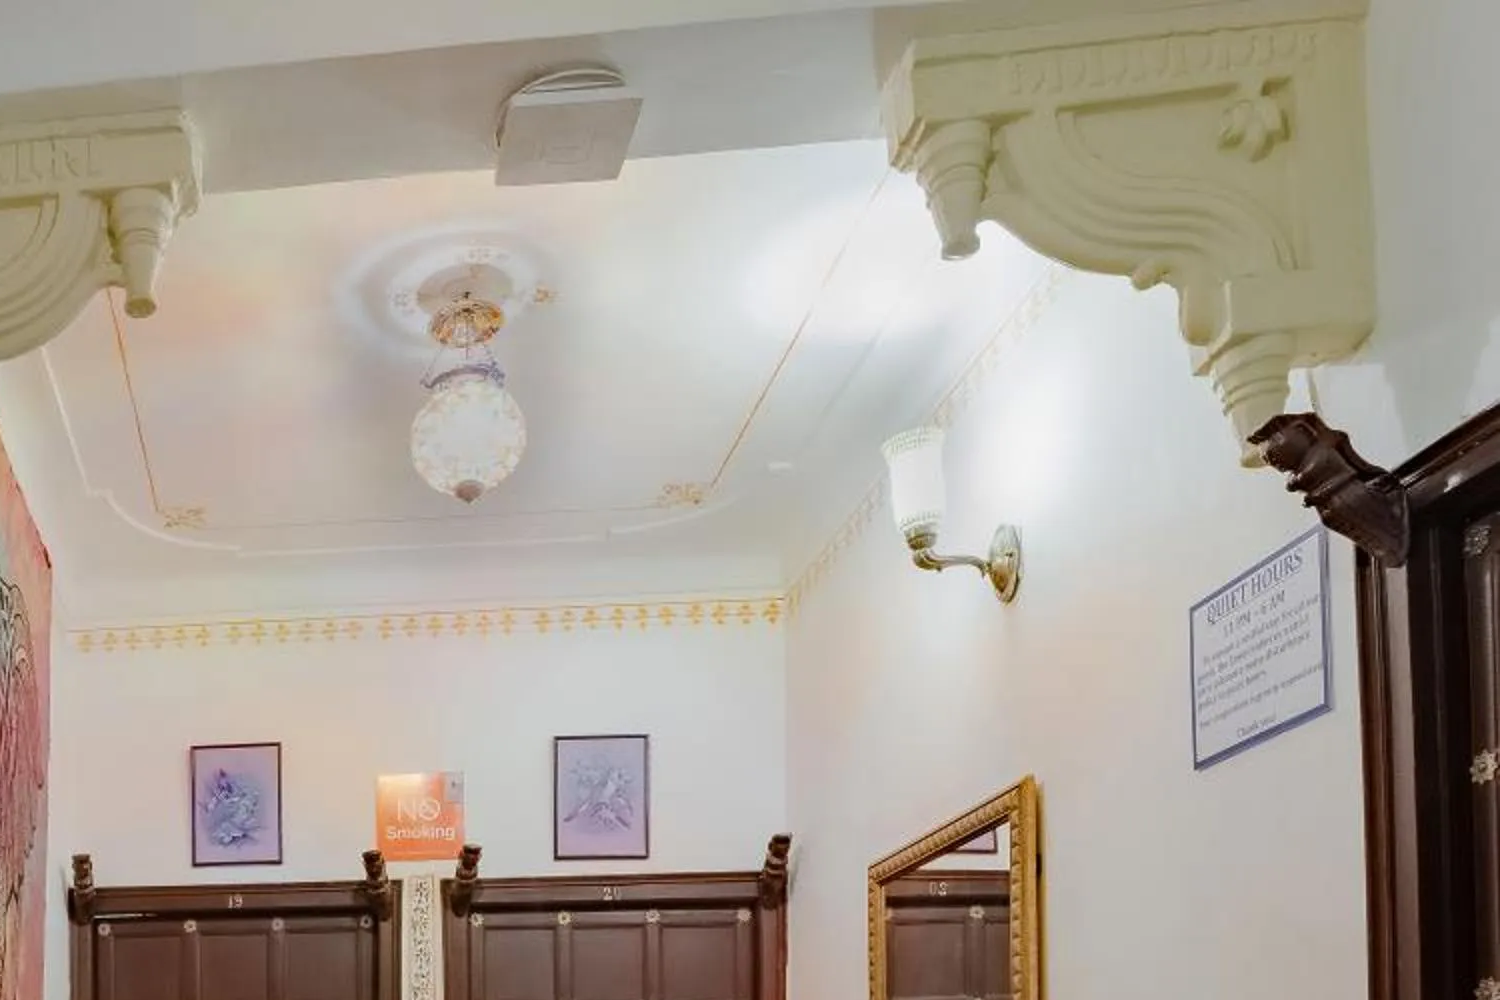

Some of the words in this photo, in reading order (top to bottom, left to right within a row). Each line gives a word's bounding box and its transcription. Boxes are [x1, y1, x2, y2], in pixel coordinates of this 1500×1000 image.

[1205, 582, 1248, 625] QUIET
[1251, 548, 1302, 597] HOURS
[397, 797, 441, 822] NO
[386, 826, 456, 841] Smoking
